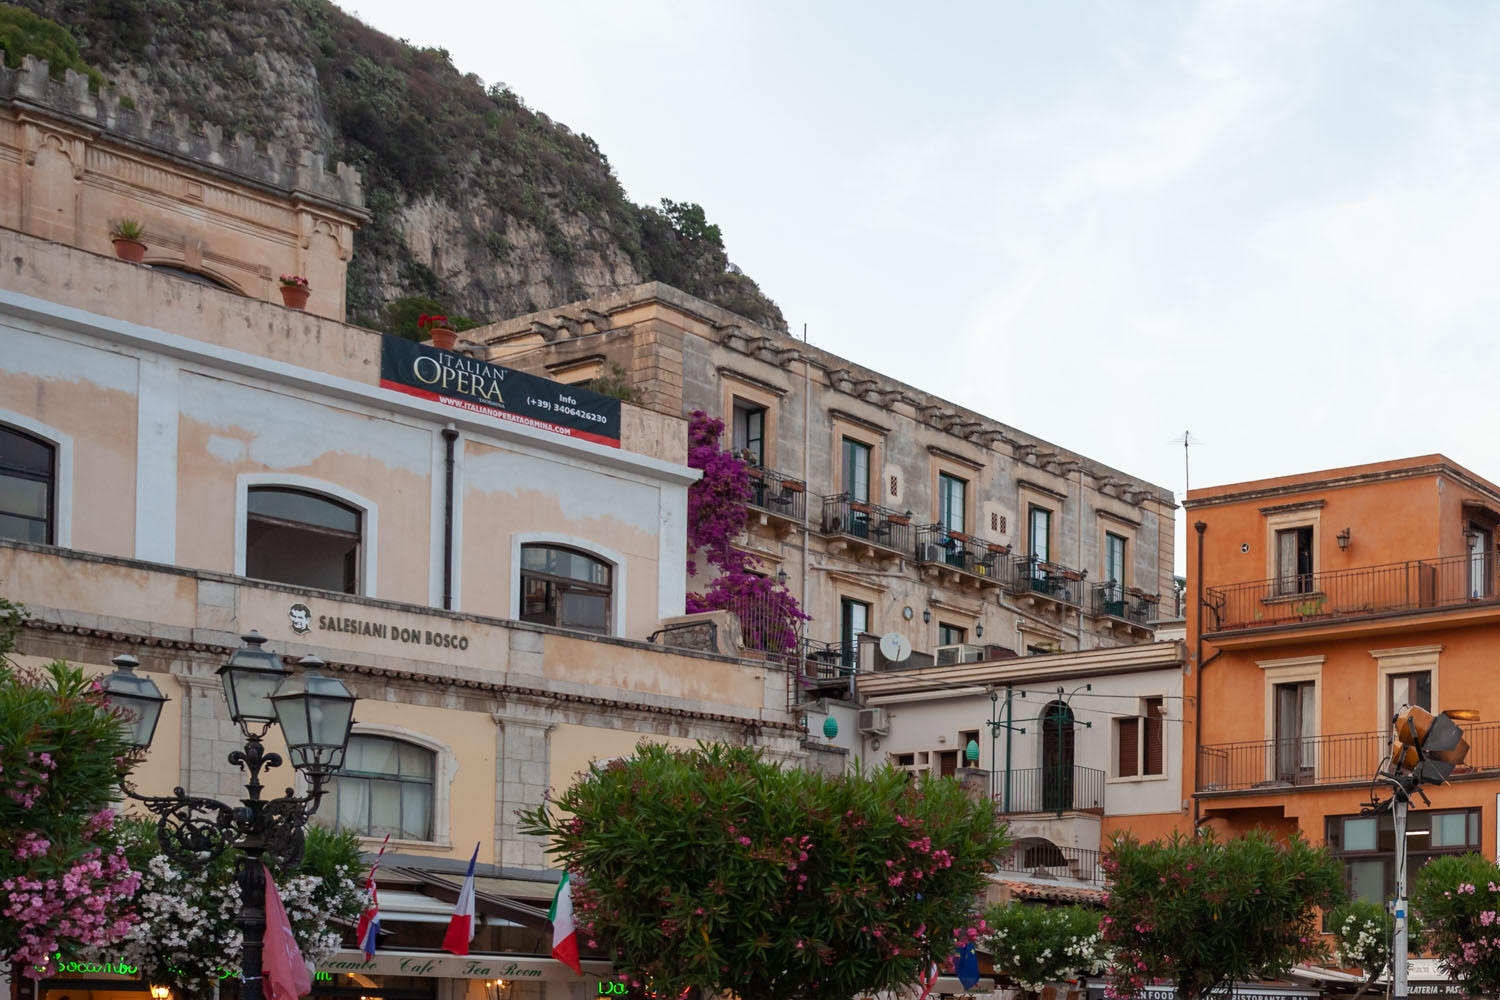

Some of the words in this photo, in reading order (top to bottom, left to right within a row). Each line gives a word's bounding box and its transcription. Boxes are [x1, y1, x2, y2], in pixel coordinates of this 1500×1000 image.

[413, 356, 504, 403] OPERA
[439, 353, 504, 381] ITALIAN
[526, 396, 552, 411] (+39)
[554, 404, 607, 424] 3406426230
[559, 394, 577, 406] Info
[439, 396, 571, 436] WWW.ITALIANOPERATAORMINA.COM
[319, 615, 387, 639] SALESIANI
[391, 626, 421, 644] DON
[425, 631, 469, 651] BOSCO
[462, 960, 491, 976] Tea
[500, 963, 542, 978] Room
[1149, 991, 1174, 1000] FOOD
